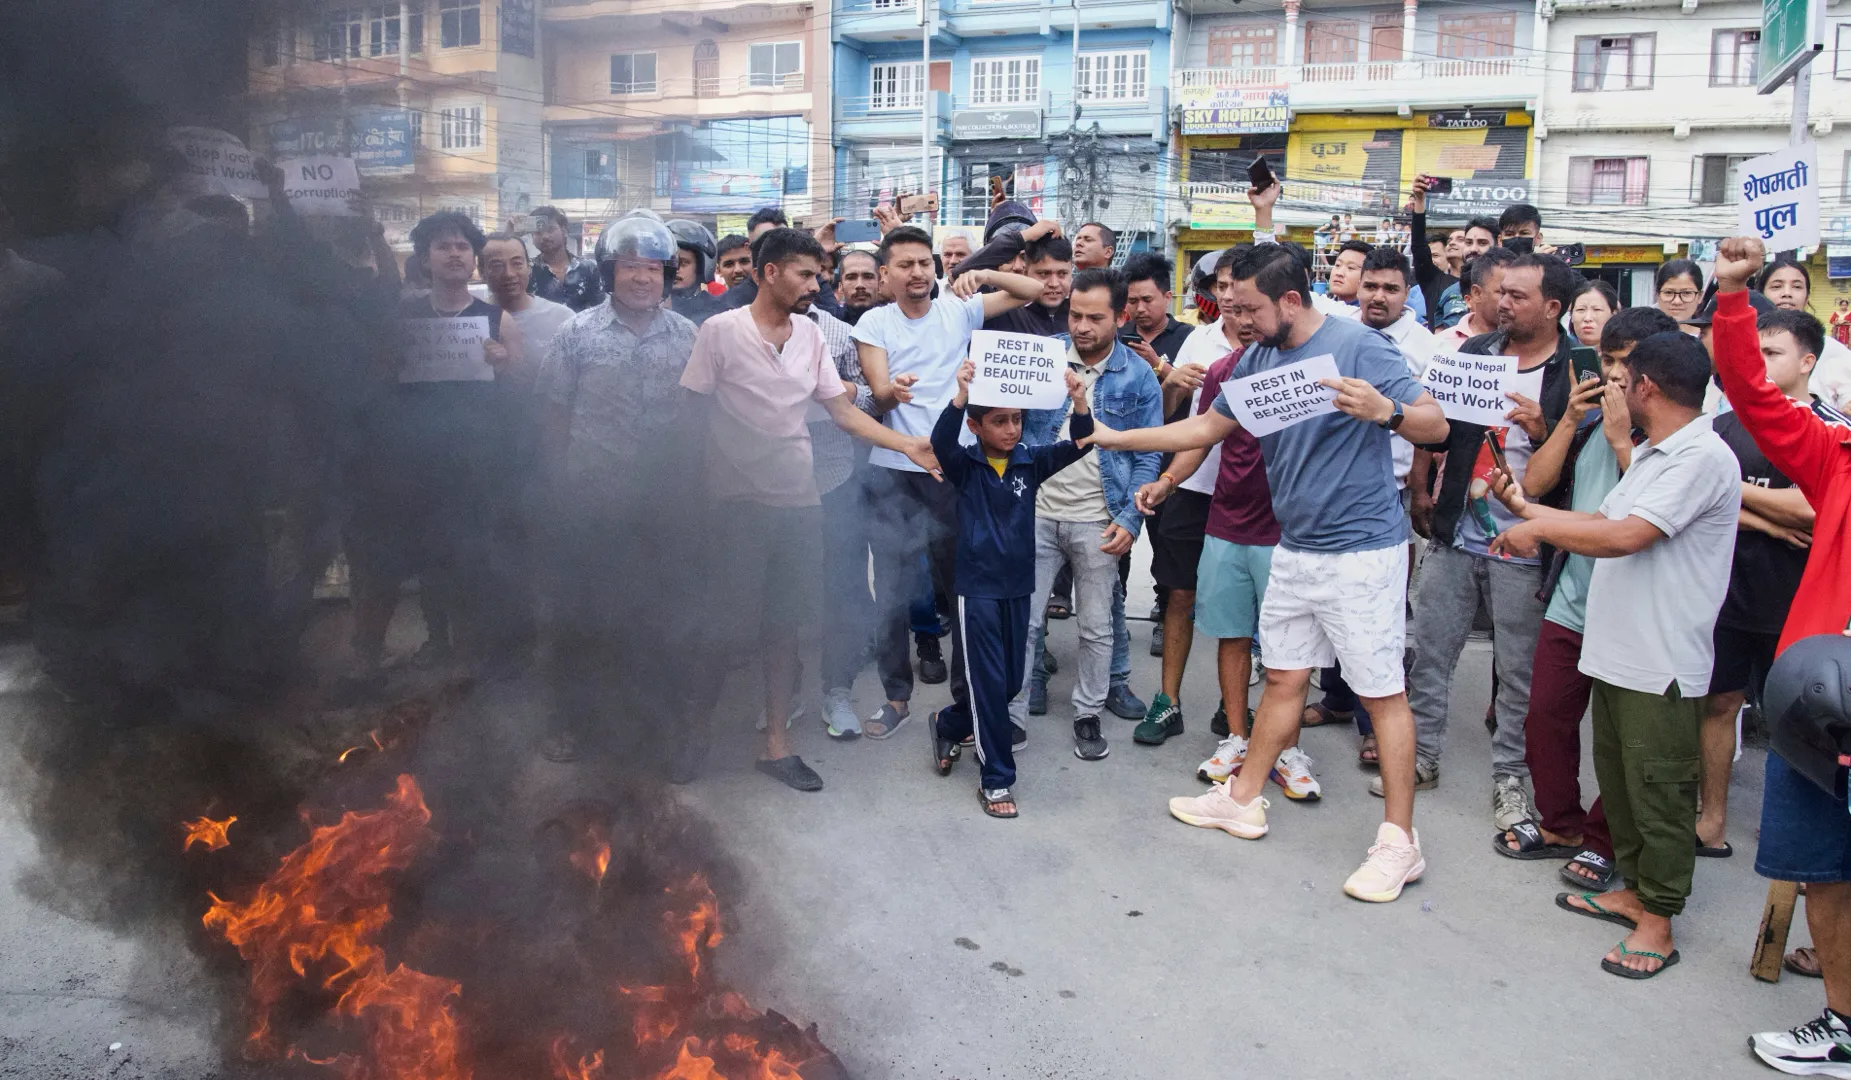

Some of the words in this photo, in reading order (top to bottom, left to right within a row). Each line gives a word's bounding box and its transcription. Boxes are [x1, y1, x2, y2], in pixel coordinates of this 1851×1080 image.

[1184, 110, 1213, 123] SKY
[1220, 107, 1287, 122] HORIZON
[1446, 119, 1488, 127] TATTOO
[221, 165, 261, 181] Work
[302, 164, 333, 181] NO
[1744, 160, 1809, 202] शेषमती
[1438, 186, 1527, 201] ATTOO
[1754, 202, 1799, 239] पुल
[448, 322, 480, 330] NEPAL
[997, 338, 1030, 351] REST
[1033, 342, 1044, 353] IN
[984, 352, 1028, 366] PEACE
[1029, 356, 1054, 368] FOR
[1459, 361, 1472, 371] up
[1475, 361, 1506, 374] Nepal
[983, 367, 1052, 383] BEAUTIFUL
[1250, 374, 1287, 393] REST
[1290, 369, 1306, 382] IN
[1428, 368, 1463, 388] Stop
[1467, 375, 1499, 391] loot
[999, 382, 1033, 396] SOUL
[1244, 389, 1293, 409] PEACE
[1293, 381, 1325, 397] FOR
[1253, 396, 1330, 420] BEAUTIFUL
[1462, 392, 1504, 411] Work
[1279, 408, 1318, 422] SOUL
[1580, 850, 1606, 864] NIKE
